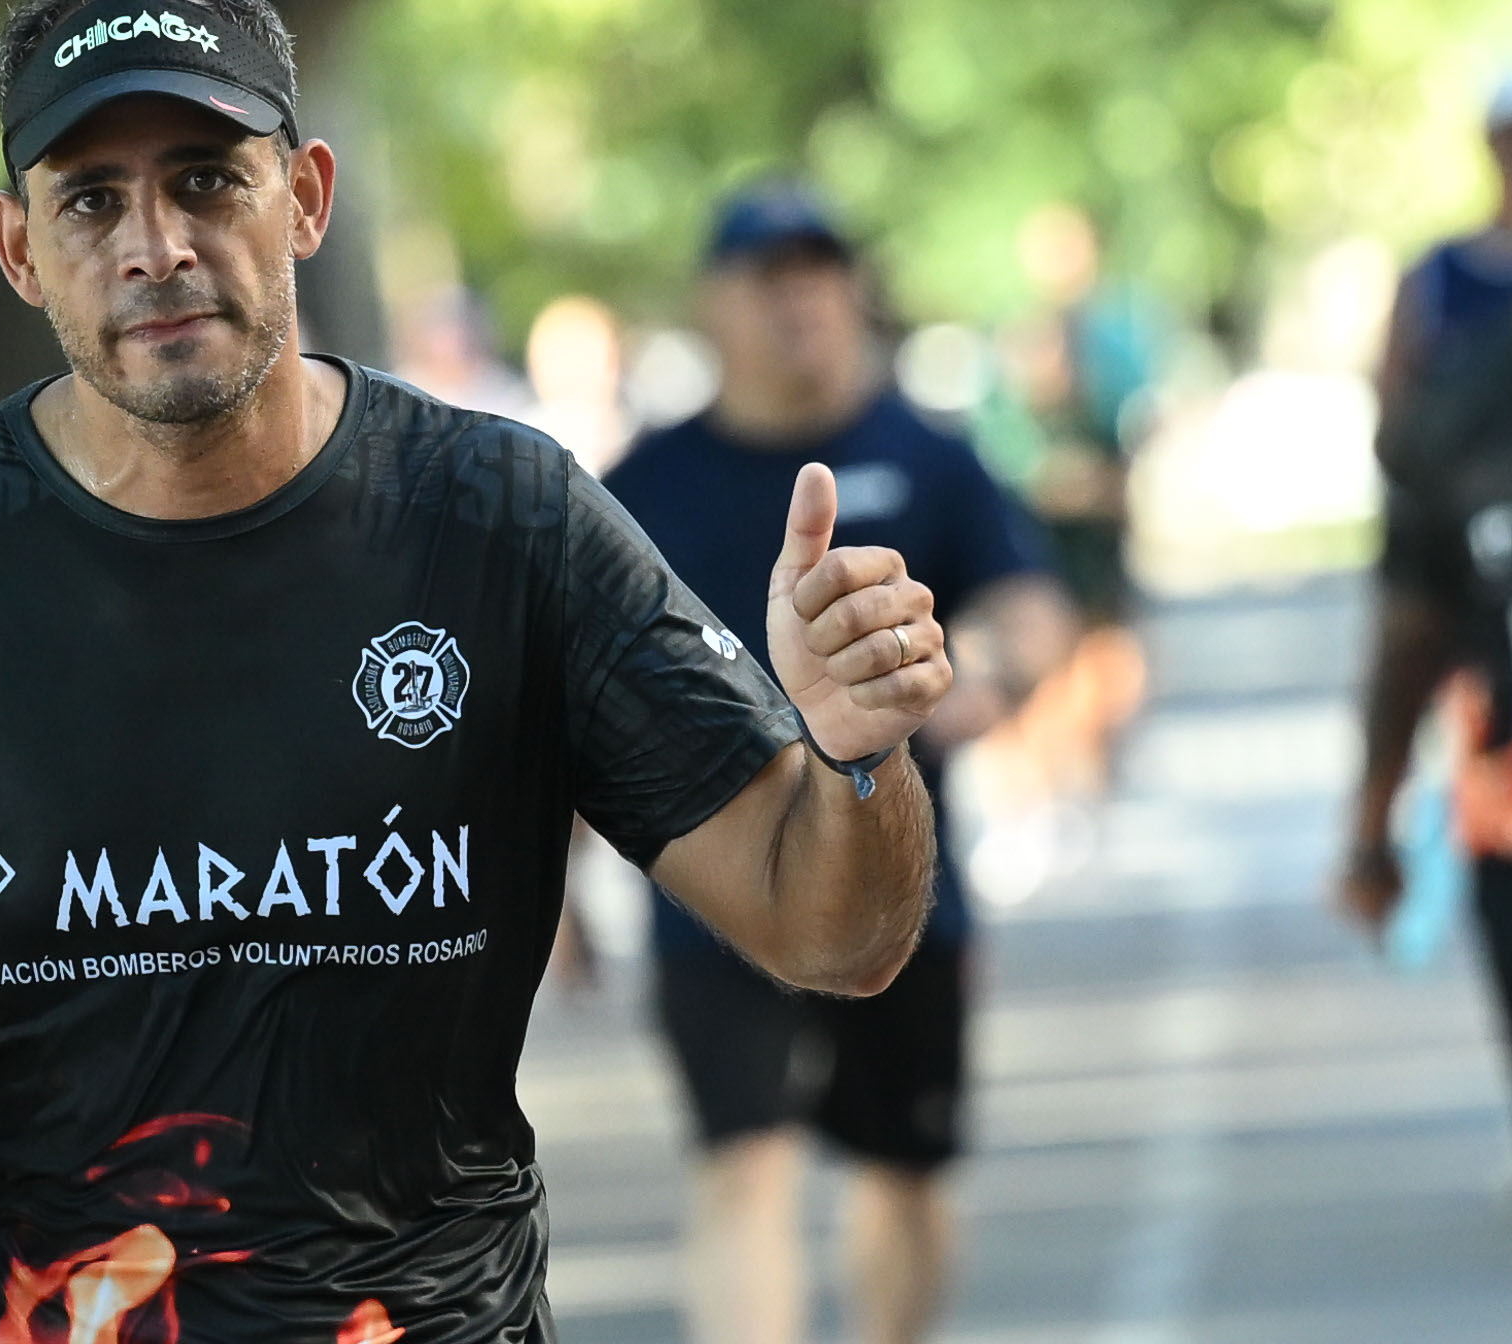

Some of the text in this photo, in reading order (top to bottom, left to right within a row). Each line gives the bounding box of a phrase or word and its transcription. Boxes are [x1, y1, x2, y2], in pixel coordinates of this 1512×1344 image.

[391, 661, 435, 705] 27
[55, 803, 471, 932] MARATÓN
[82, 946, 222, 980] BOMBEROS
[228, 941, 401, 968] VOLUNTARIOS
[407, 928, 488, 965] ROSARIO
